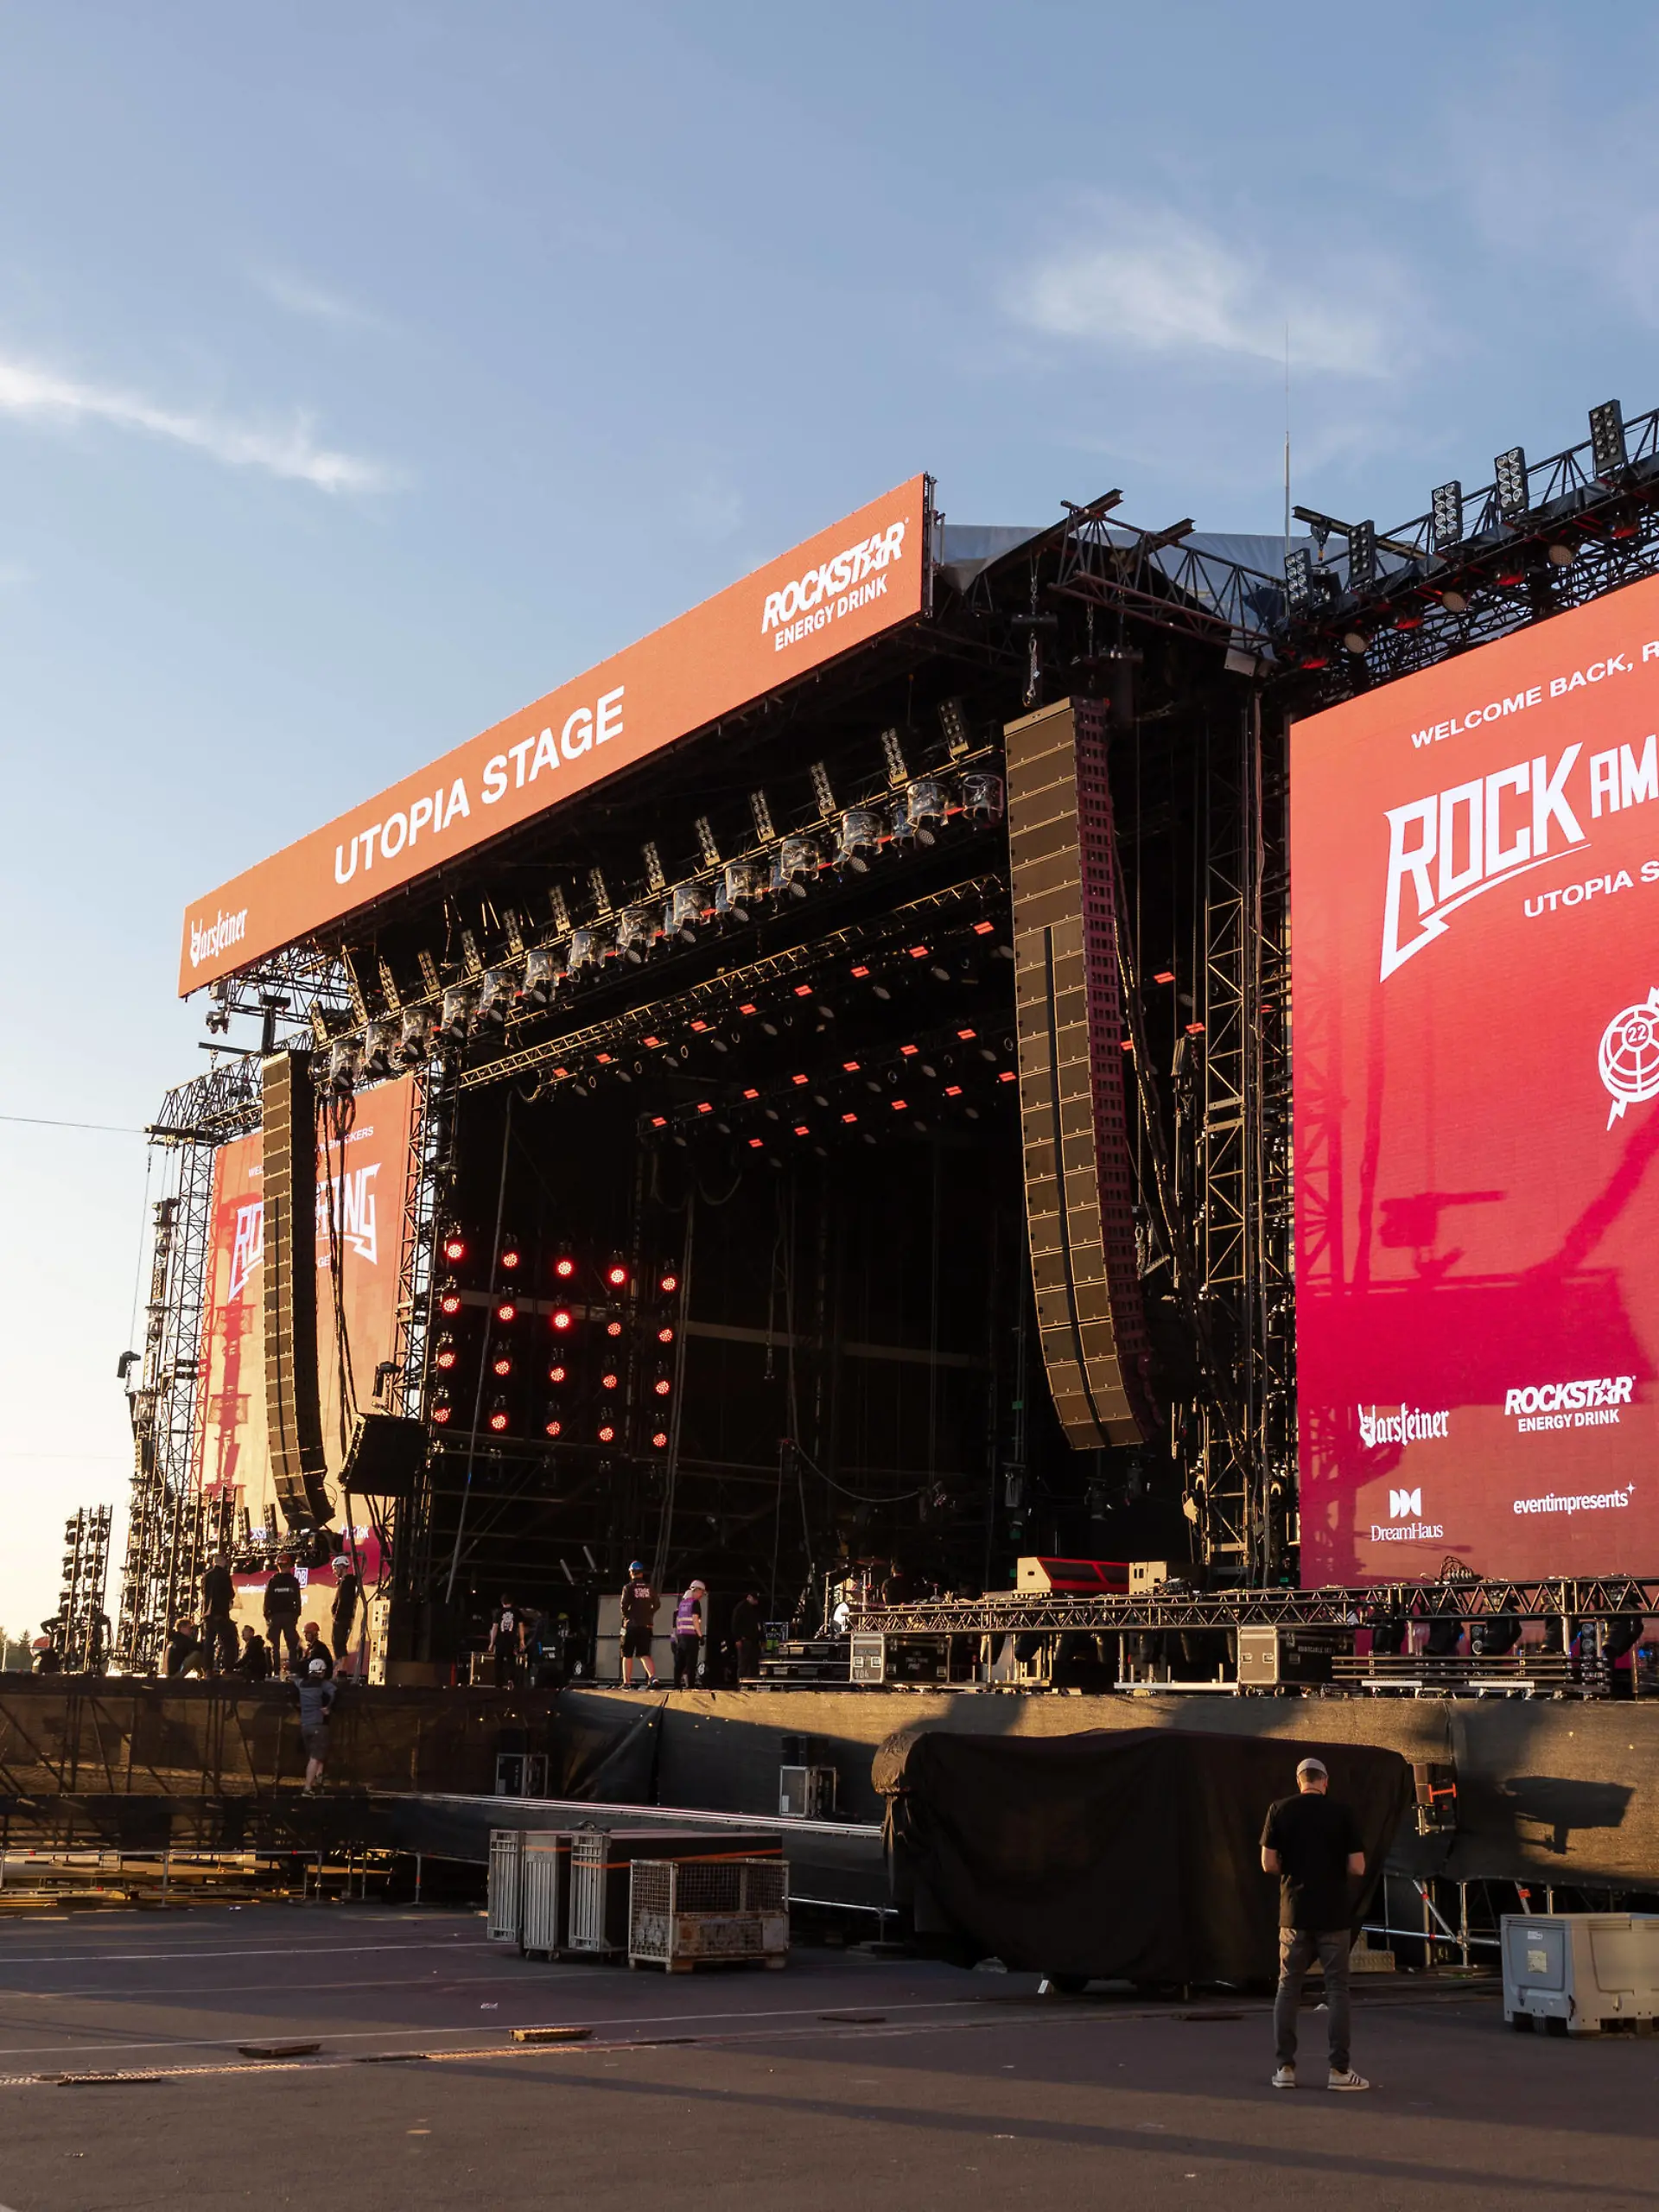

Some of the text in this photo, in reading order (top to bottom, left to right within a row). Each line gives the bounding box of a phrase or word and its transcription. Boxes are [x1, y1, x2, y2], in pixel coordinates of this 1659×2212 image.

[761, 521, 906, 635] ROCKSTAR
[775, 574, 887, 652] ENERGY DRINK
[1411, 685, 1541, 749] WELCOME
[1549, 653, 1633, 698] BACK,
[334, 685, 625, 884] UTOPIA STAGE
[1380, 741, 1592, 983] ROCK
[1523, 869, 1633, 918] UTOPIA
[1628, 1025, 1647, 1044] 22
[1504, 1376, 1633, 1415] ROCKSTAR
[1517, 1408, 1620, 1433] ENERGY DRINK
[1513, 1490, 1629, 1515] eventimpresents
[1370, 1522, 1444, 1541] DreamHaus
